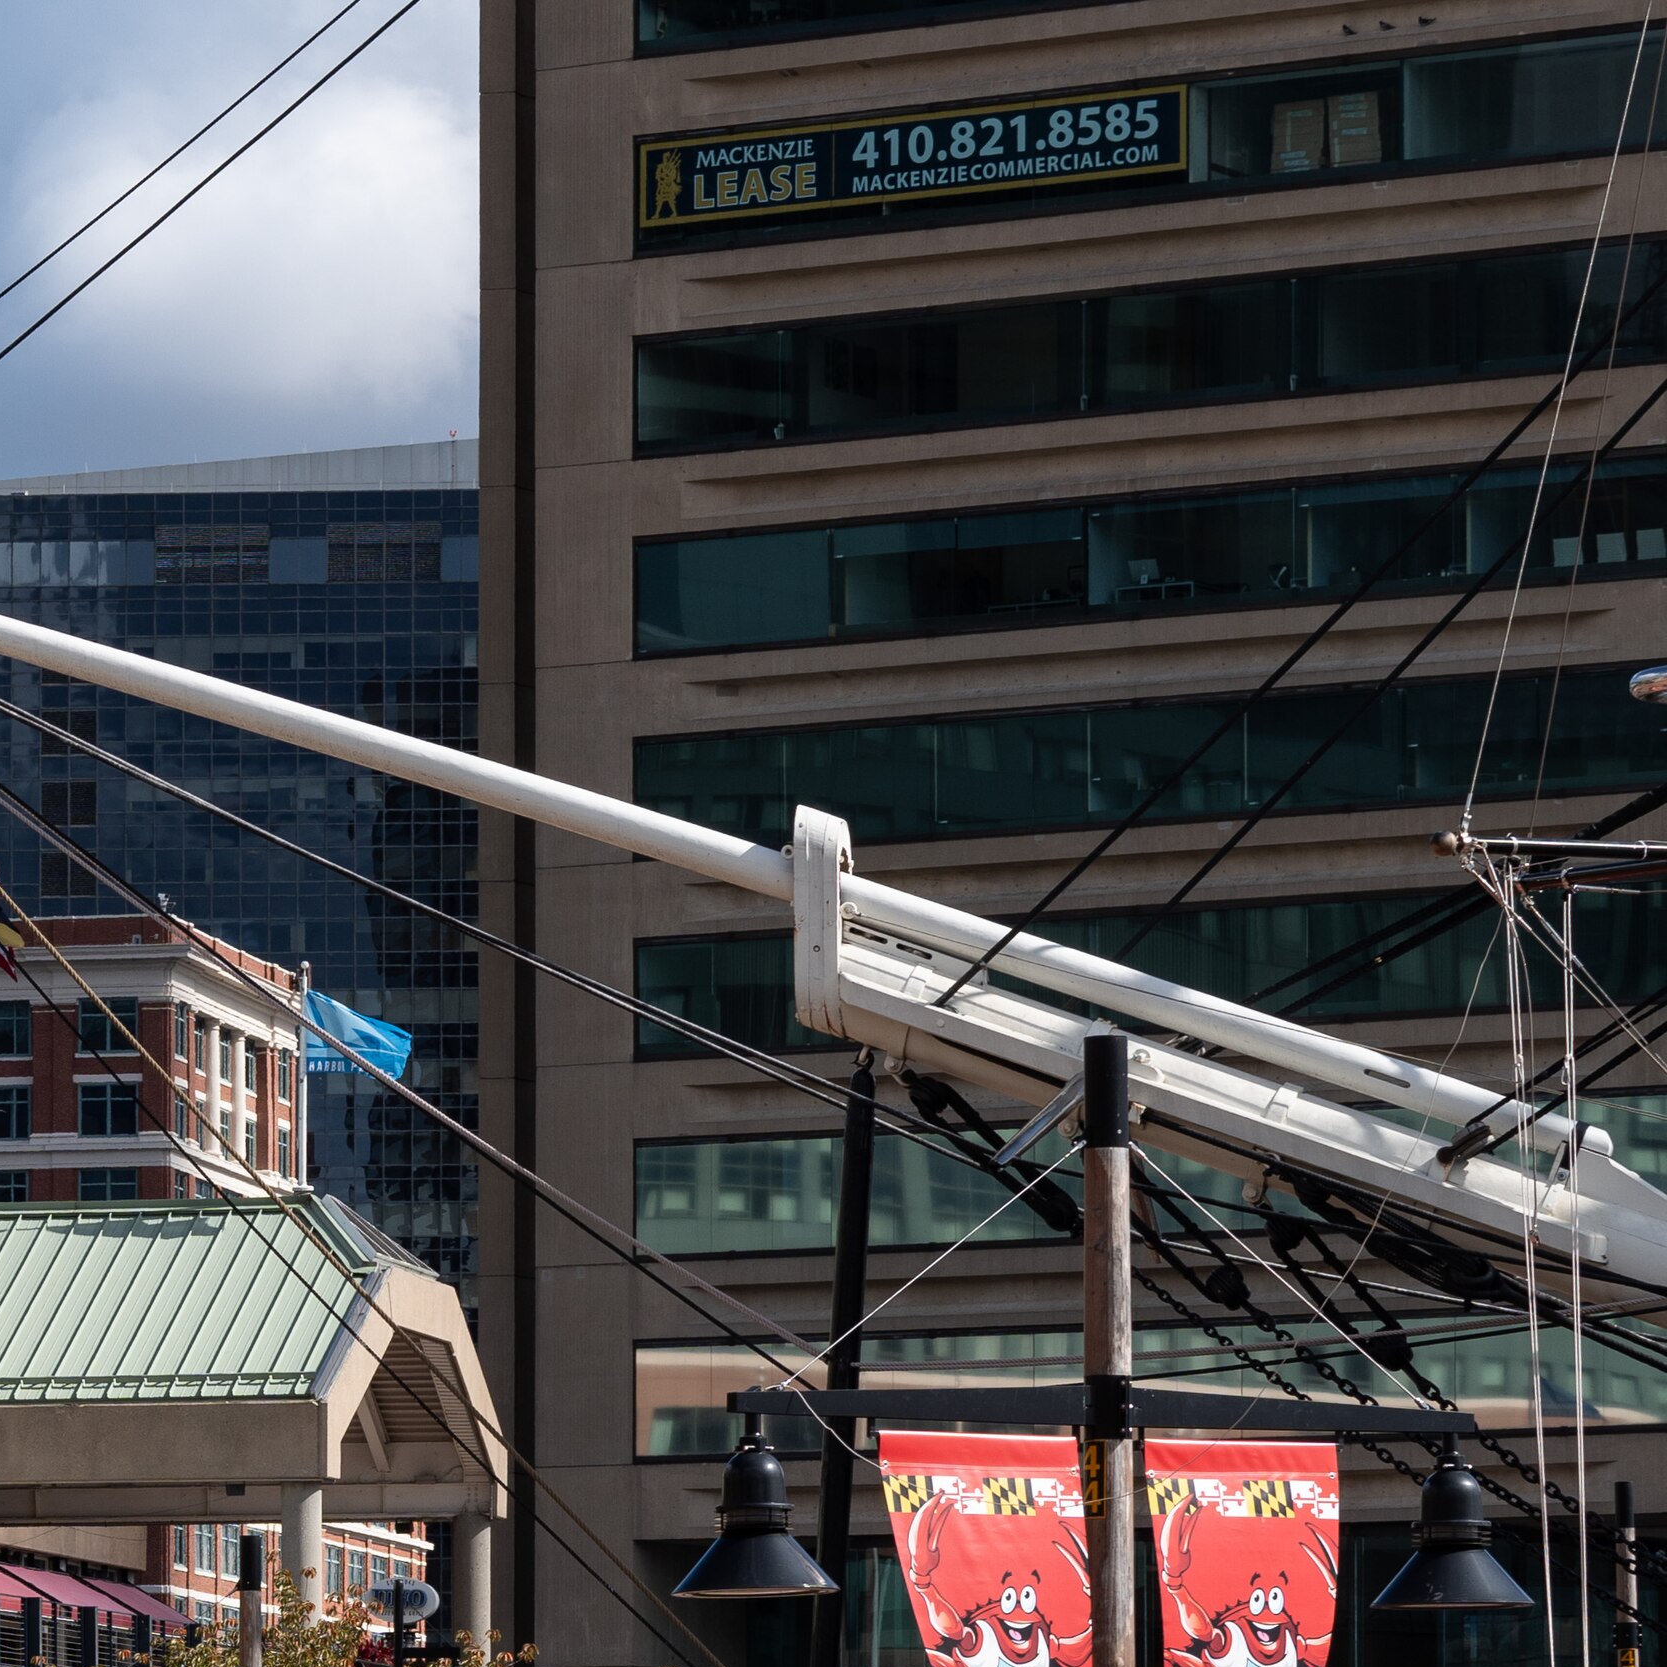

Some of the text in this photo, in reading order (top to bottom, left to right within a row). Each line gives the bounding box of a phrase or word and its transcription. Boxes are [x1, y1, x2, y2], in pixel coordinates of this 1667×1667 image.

[695, 139, 815, 169] MACKENZIE
[852, 99, 1159, 169] 410.821.8585
[693, 162, 817, 210] LEASE
[852, 144, 1159, 193] MACKENZIECOMMERCIAL.COM
